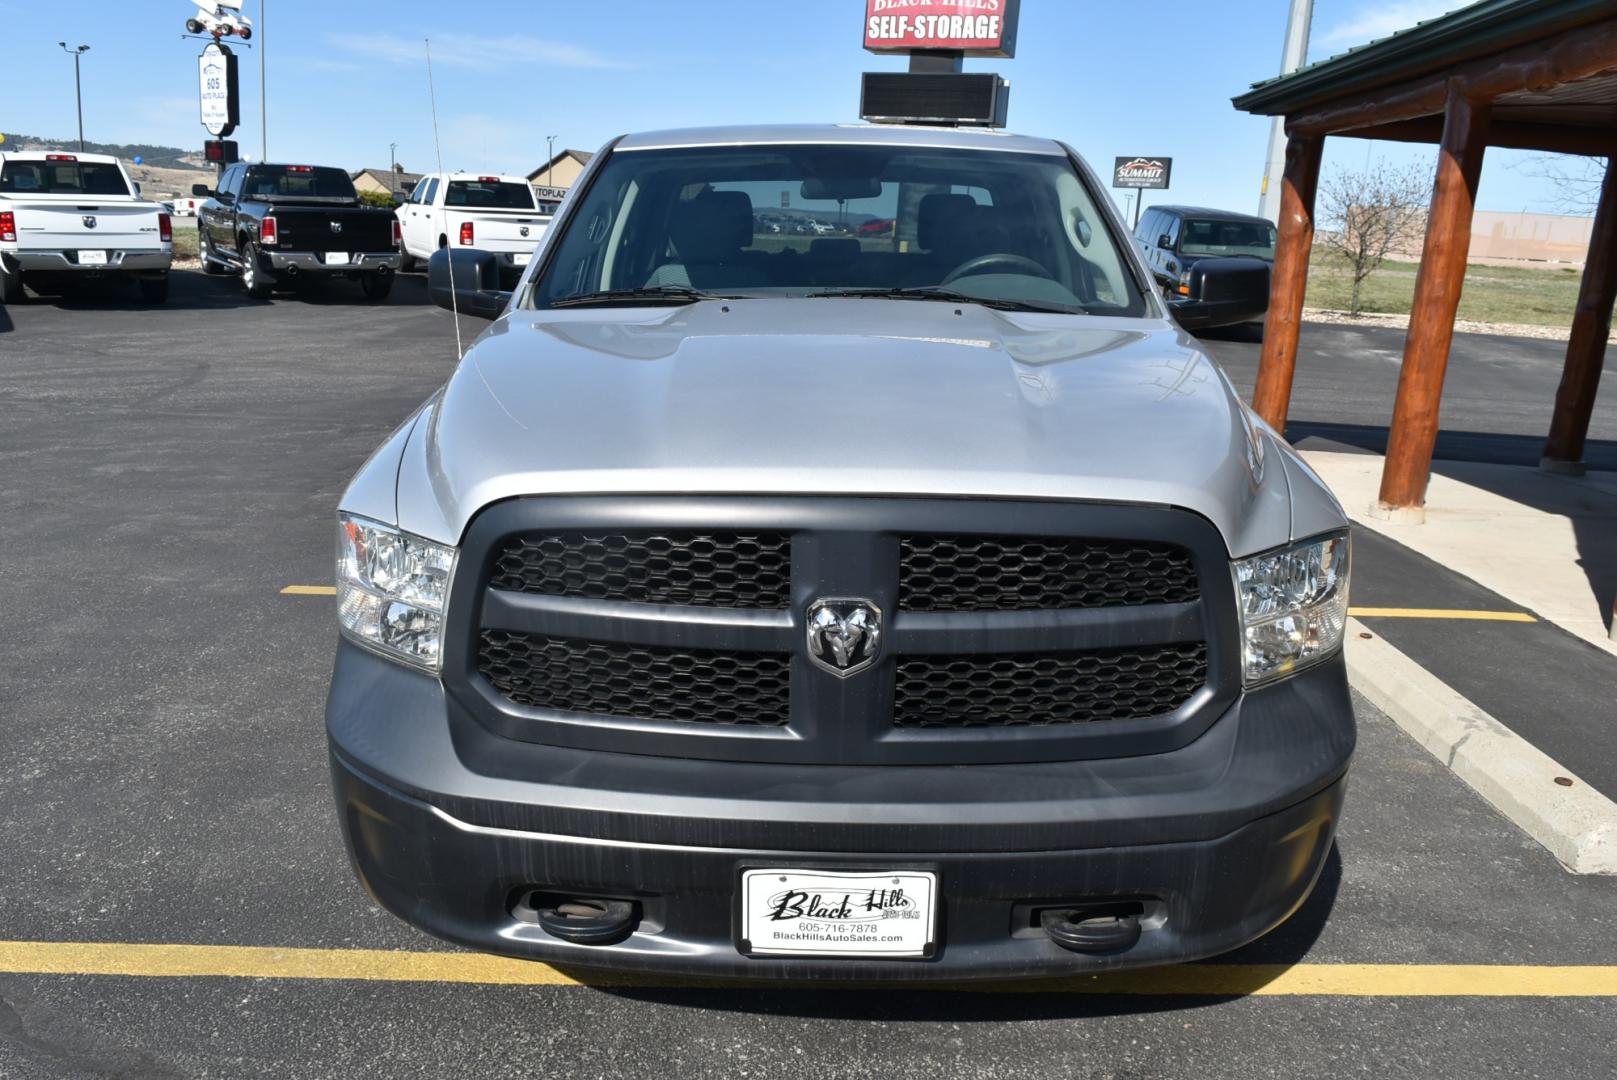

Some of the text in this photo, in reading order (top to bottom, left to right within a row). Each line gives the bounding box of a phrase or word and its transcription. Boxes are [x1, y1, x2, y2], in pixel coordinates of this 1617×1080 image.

[868, 15, 1000, 39] SELF-STORAGE
[207, 78, 220, 90] 605
[1118, 169, 1163, 178] SUMMIT
[761, 888, 908, 922] Black Hills
[799, 922, 878, 933] 605-716-7878
[773, 931, 904, 943] BlackHillsAutoSales.com
